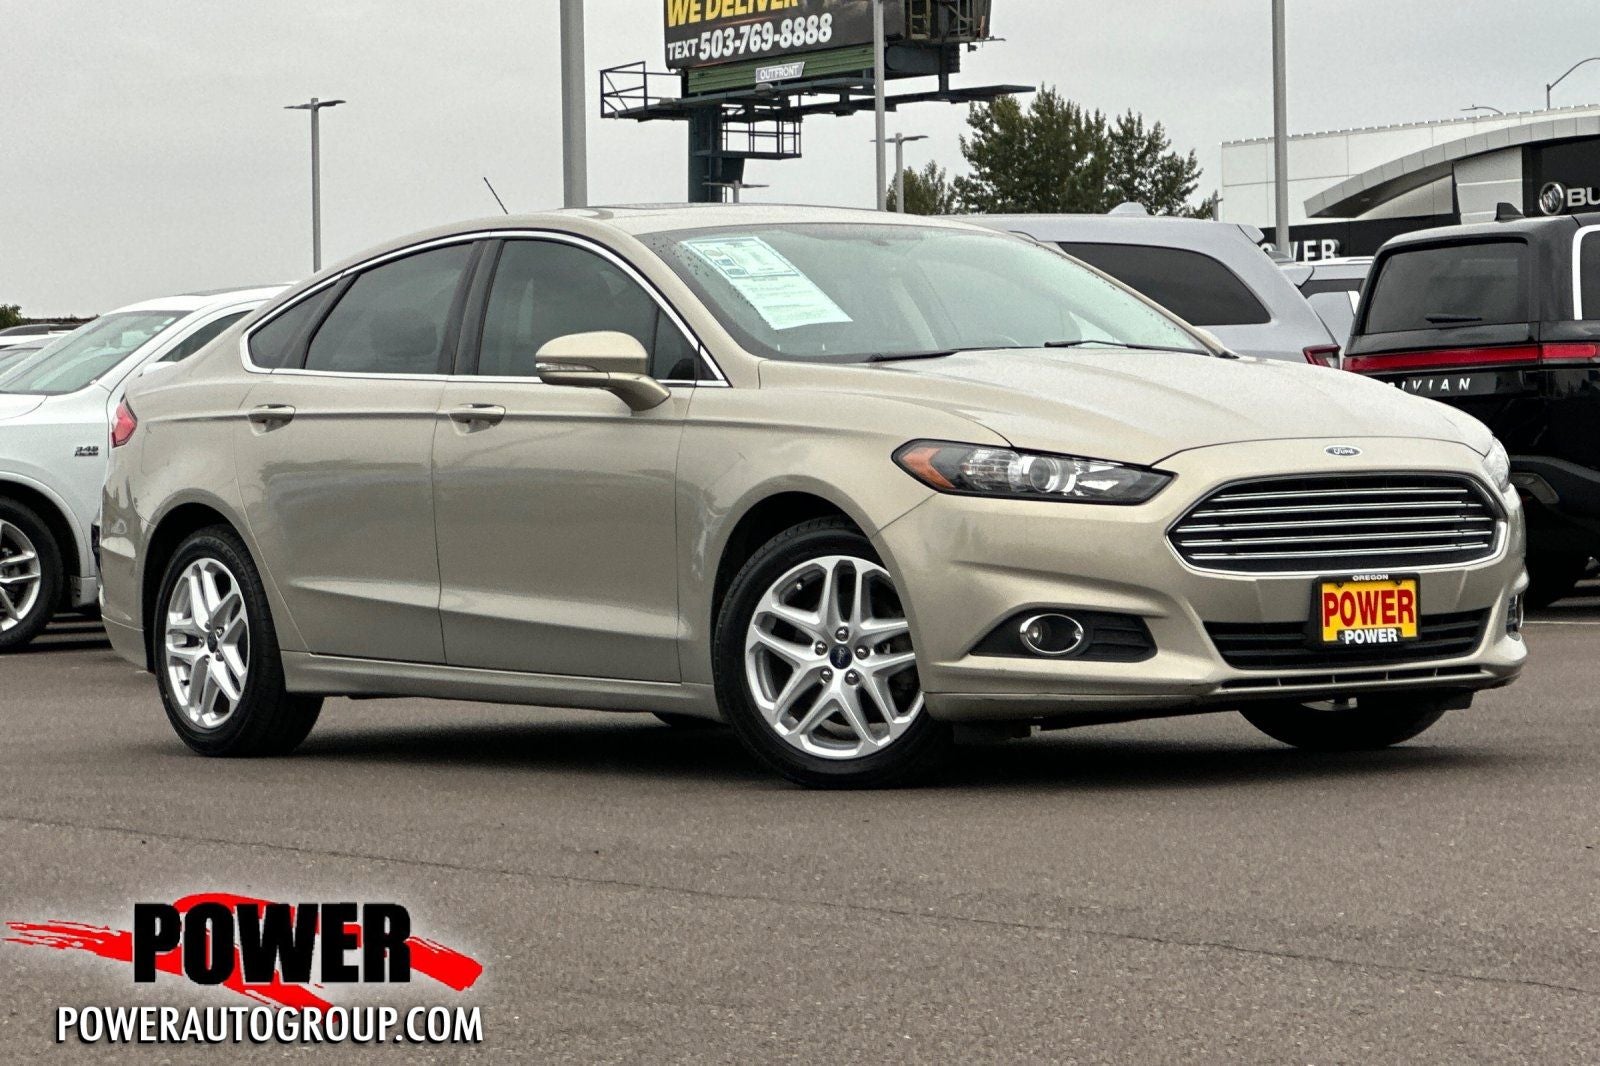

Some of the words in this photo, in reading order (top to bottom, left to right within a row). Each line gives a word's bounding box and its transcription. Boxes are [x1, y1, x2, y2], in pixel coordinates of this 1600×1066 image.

[668, 0, 701, 27] WE
[706, 0, 798, 20] DELI
[668, 38, 698, 60] TEXT
[700, 13, 832, 60] 503-769-8888
[760, 65, 799, 80] OUTFRONT
[1352, 574, 1389, 582] OREGON
[1323, 589, 1415, 628] POWER
[1344, 628, 1398, 645] POWER
